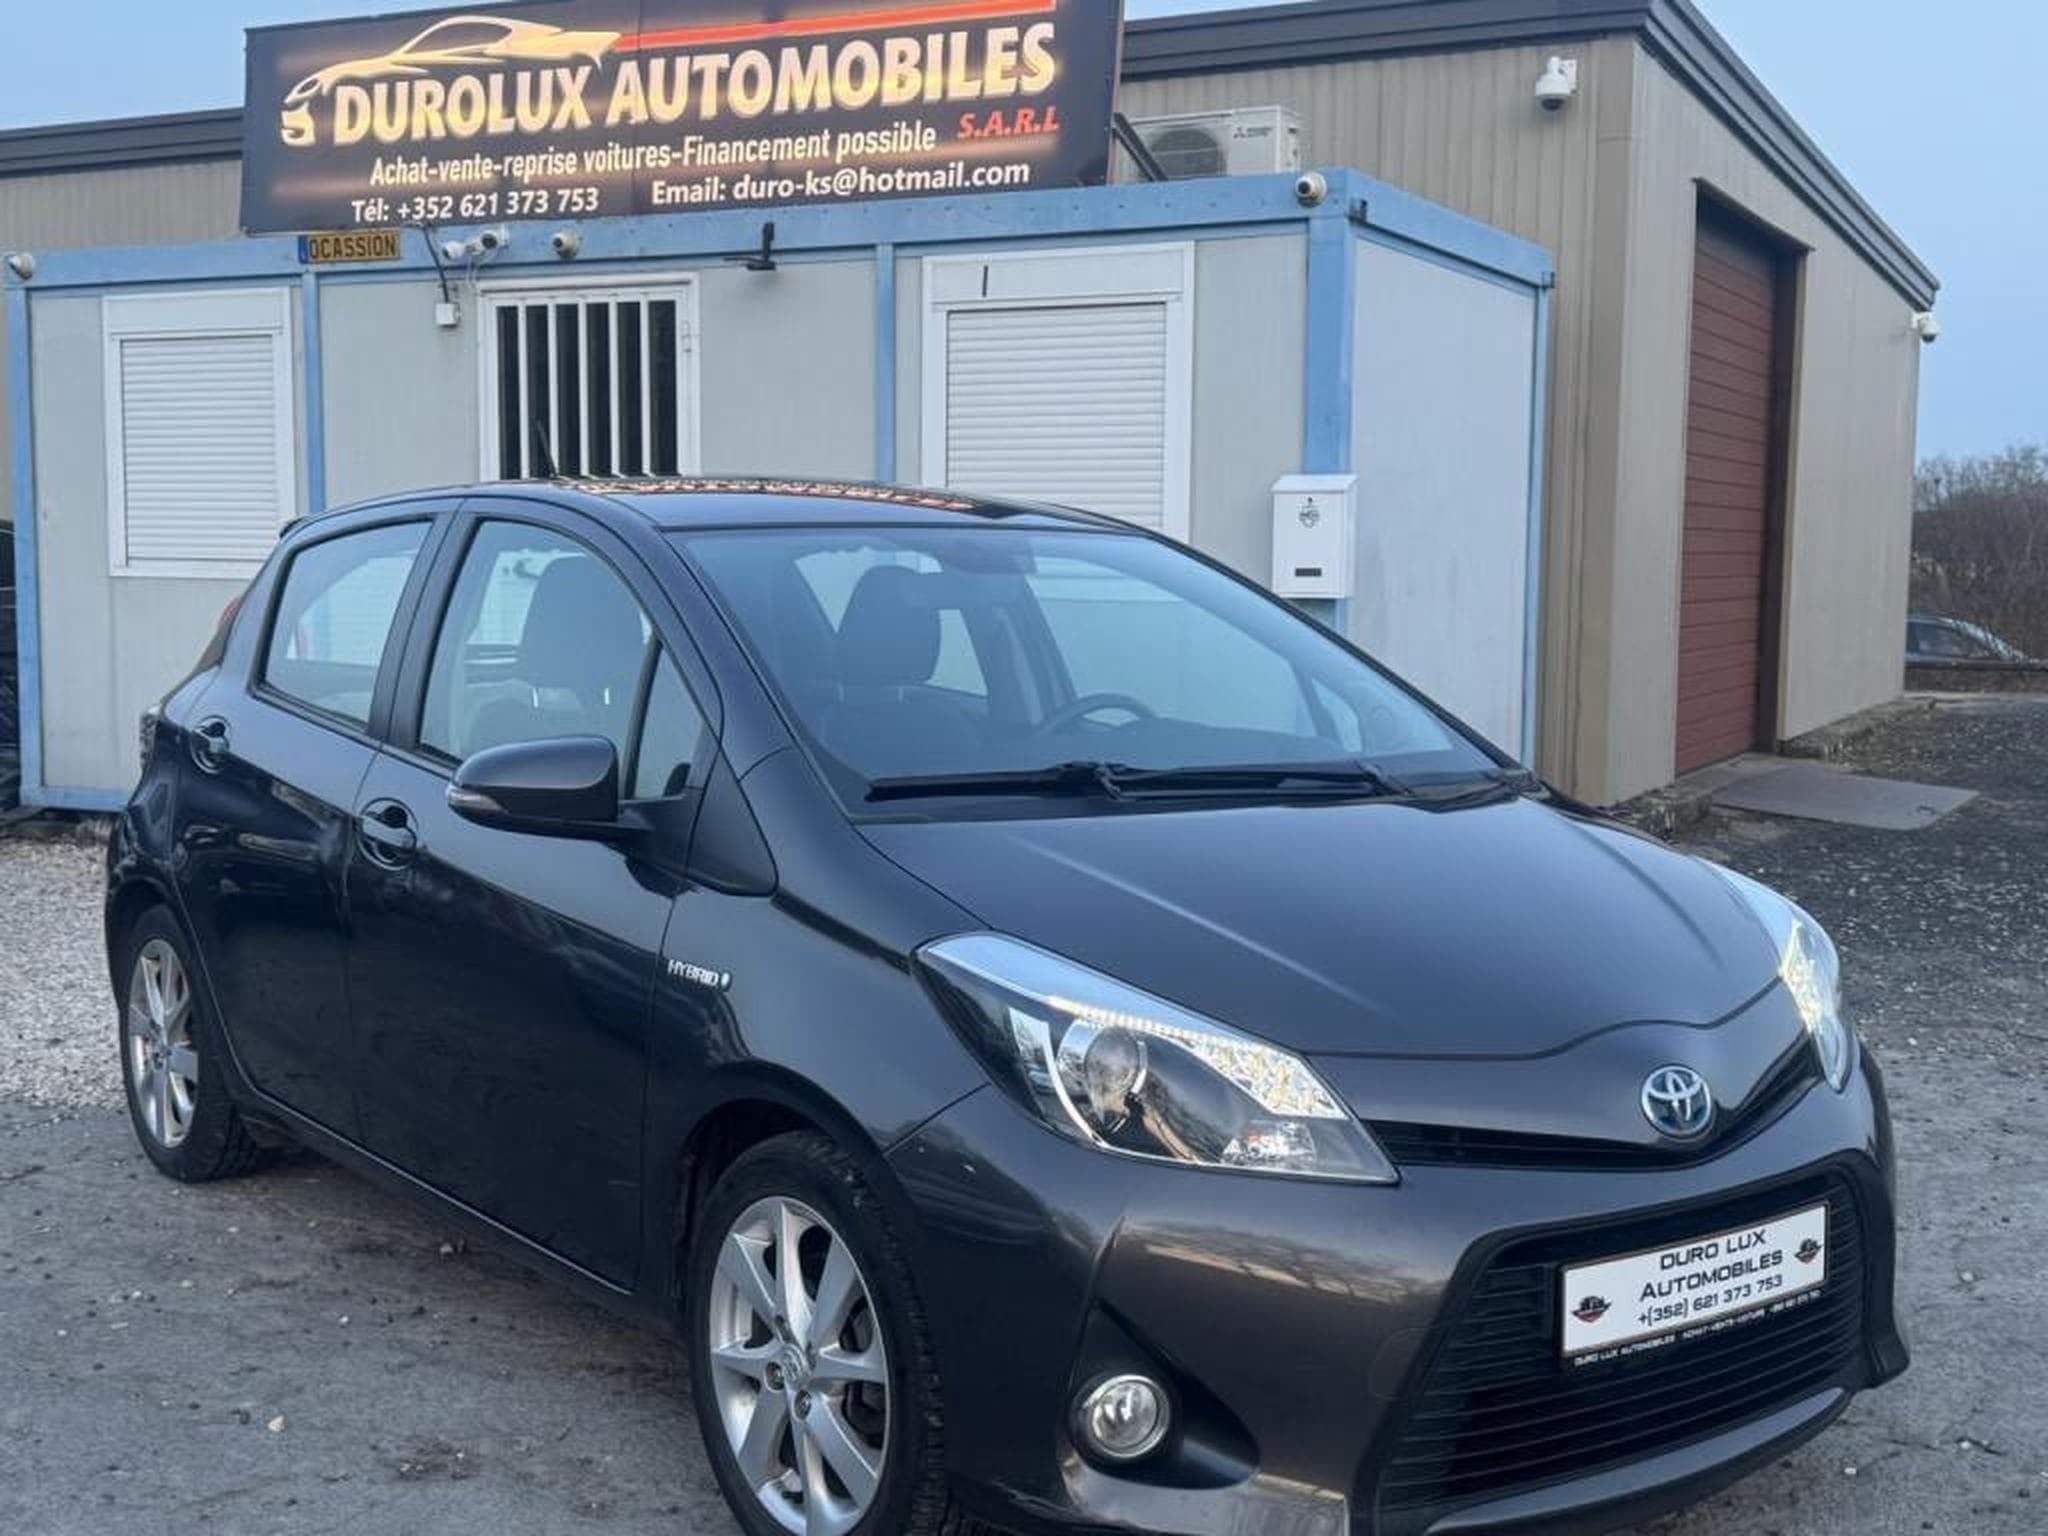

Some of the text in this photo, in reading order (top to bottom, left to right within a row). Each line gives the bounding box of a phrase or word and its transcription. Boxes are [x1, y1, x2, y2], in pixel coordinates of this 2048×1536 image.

[333, 22, 1057, 146] DUROLUX AUTOMOBILES
[370, 119, 936, 187] Achat-vente-reprise voitures-Financement possible
[351, 187, 599, 222] Tél: +352 621 373 753
[651, 160, 1030, 205] Email: duro-ks@hotmail.com
[309, 235, 396, 259] OCASSION
[668, 959, 719, 987] HYBRID
[1660, 1229, 1767, 1271] DURO LUX
[1640, 1250, 1784, 1302] AUTOMOBILES
[1638, 1298, 1689, 1327] +(352)
[1693, 1293, 1719, 1312] 621
[1724, 1283, 1752, 1303] 373
[1757, 1274, 1783, 1293] 753
